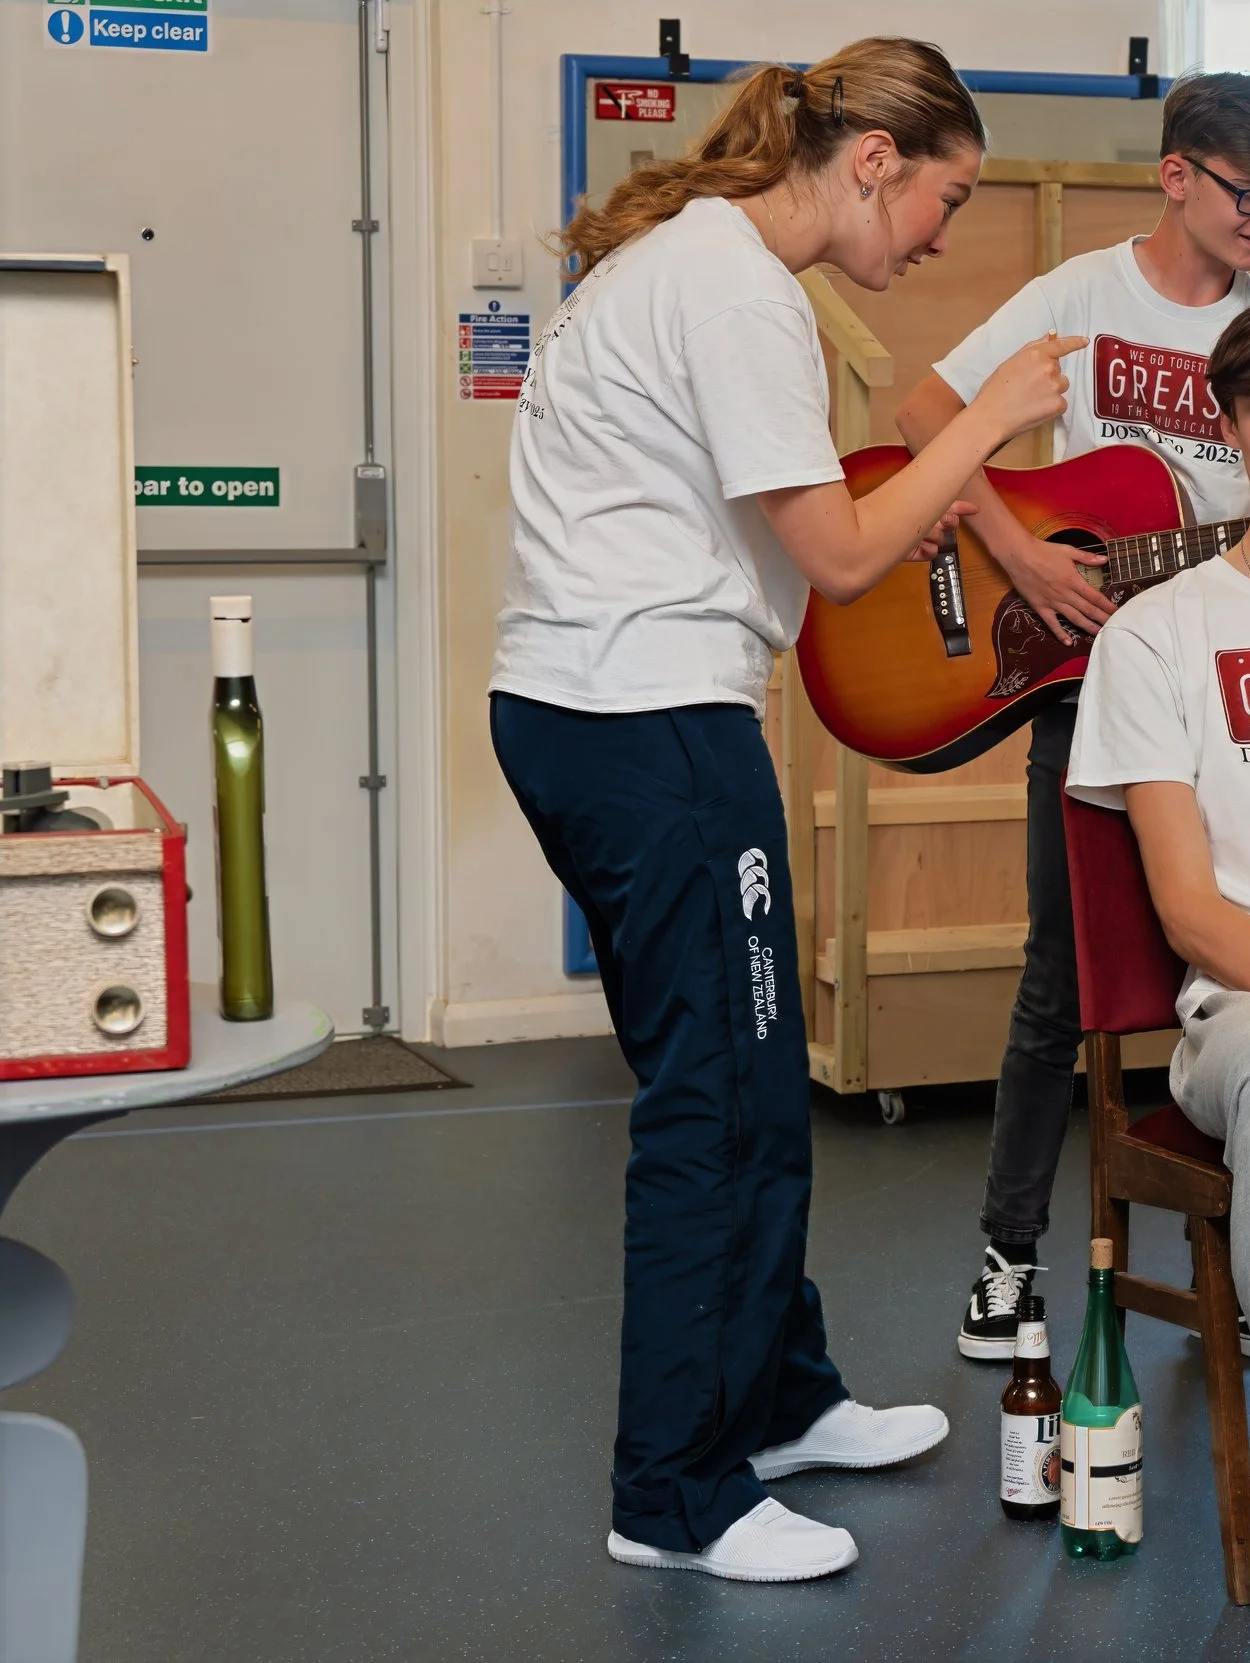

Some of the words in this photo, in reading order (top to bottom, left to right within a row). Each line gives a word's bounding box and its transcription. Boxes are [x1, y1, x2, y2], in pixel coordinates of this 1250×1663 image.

[94, 18, 147, 42] Keep
[151, 22, 204, 41] clear
[636, 98, 670, 108] SMOKING
[647, 89, 659, 98] NO
[639, 108, 667, 118] PLEASE
[470, 315, 488, 323] Fire
[489, 315, 519, 323] Action
[1130, 349, 1145, 362] WE
[1150, 353, 1164, 366] GO
[1170, 356, 1209, 375] TOGET
[1108, 358, 1221, 420] GREAS
[1127, 405, 1150, 419] THE
[1154, 414, 1214, 436] MUSICAL
[1193, 443, 1241, 464] 2025
[178, 477, 205, 496] to
[211, 480, 275, 501] open
[748, 935, 760, 953] OF
[750, 955, 762, 982] NEW
[761, 946, 778, 1021] CANTERBURY
[752, 983, 767, 1040] ZEALAND
[1035, 1414, 1061, 1444] Lit
